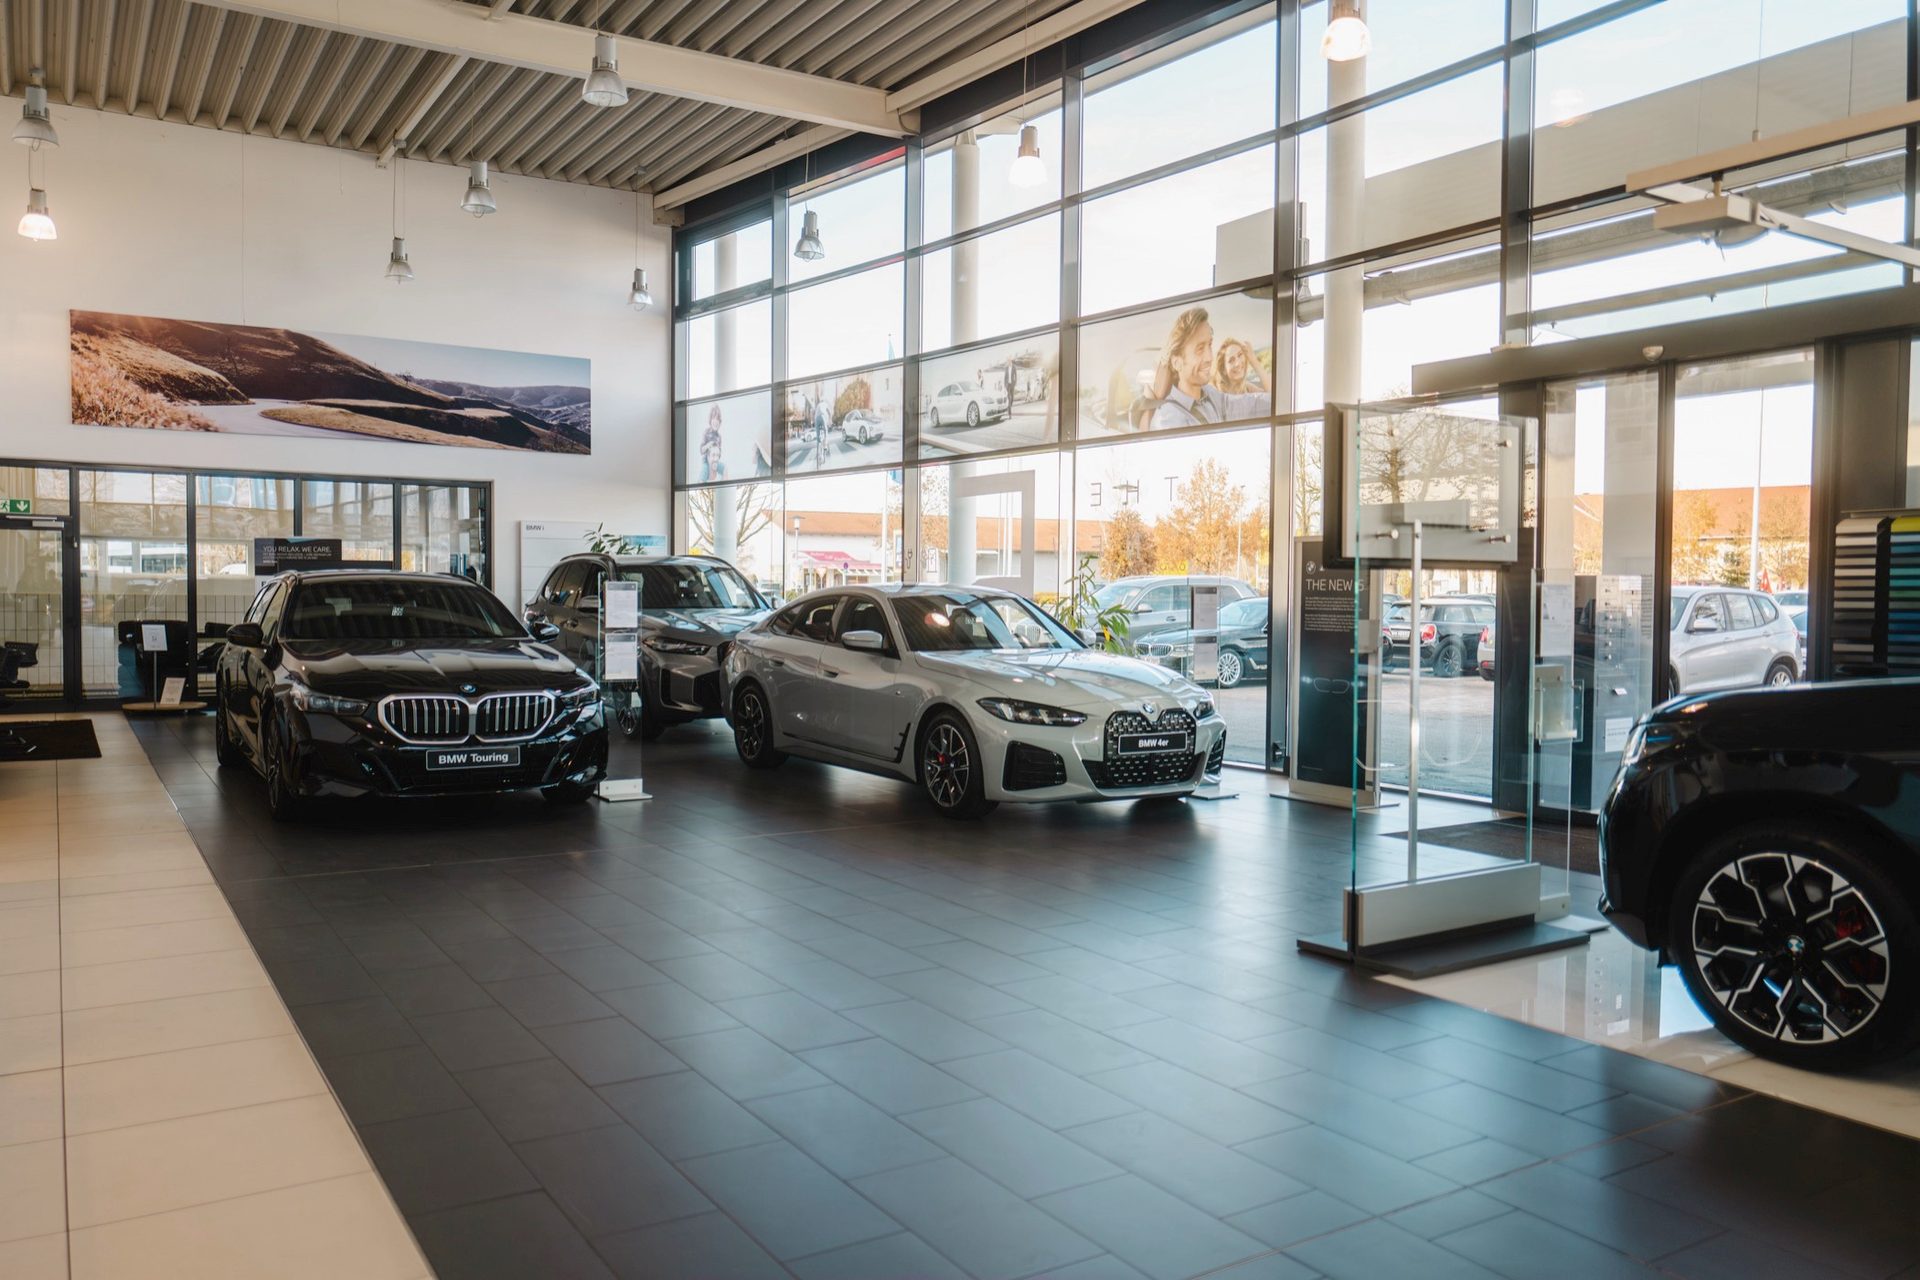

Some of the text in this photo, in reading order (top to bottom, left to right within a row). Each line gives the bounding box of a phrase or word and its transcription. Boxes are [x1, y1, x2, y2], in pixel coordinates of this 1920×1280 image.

[263, 545, 276, 553] YOU
[1305, 579, 1327, 591] THE
[1328, 579, 1353, 591] NEW
[1138, 738, 1169, 748] BMW 4er
[438, 752, 509, 764] BMW Touring
